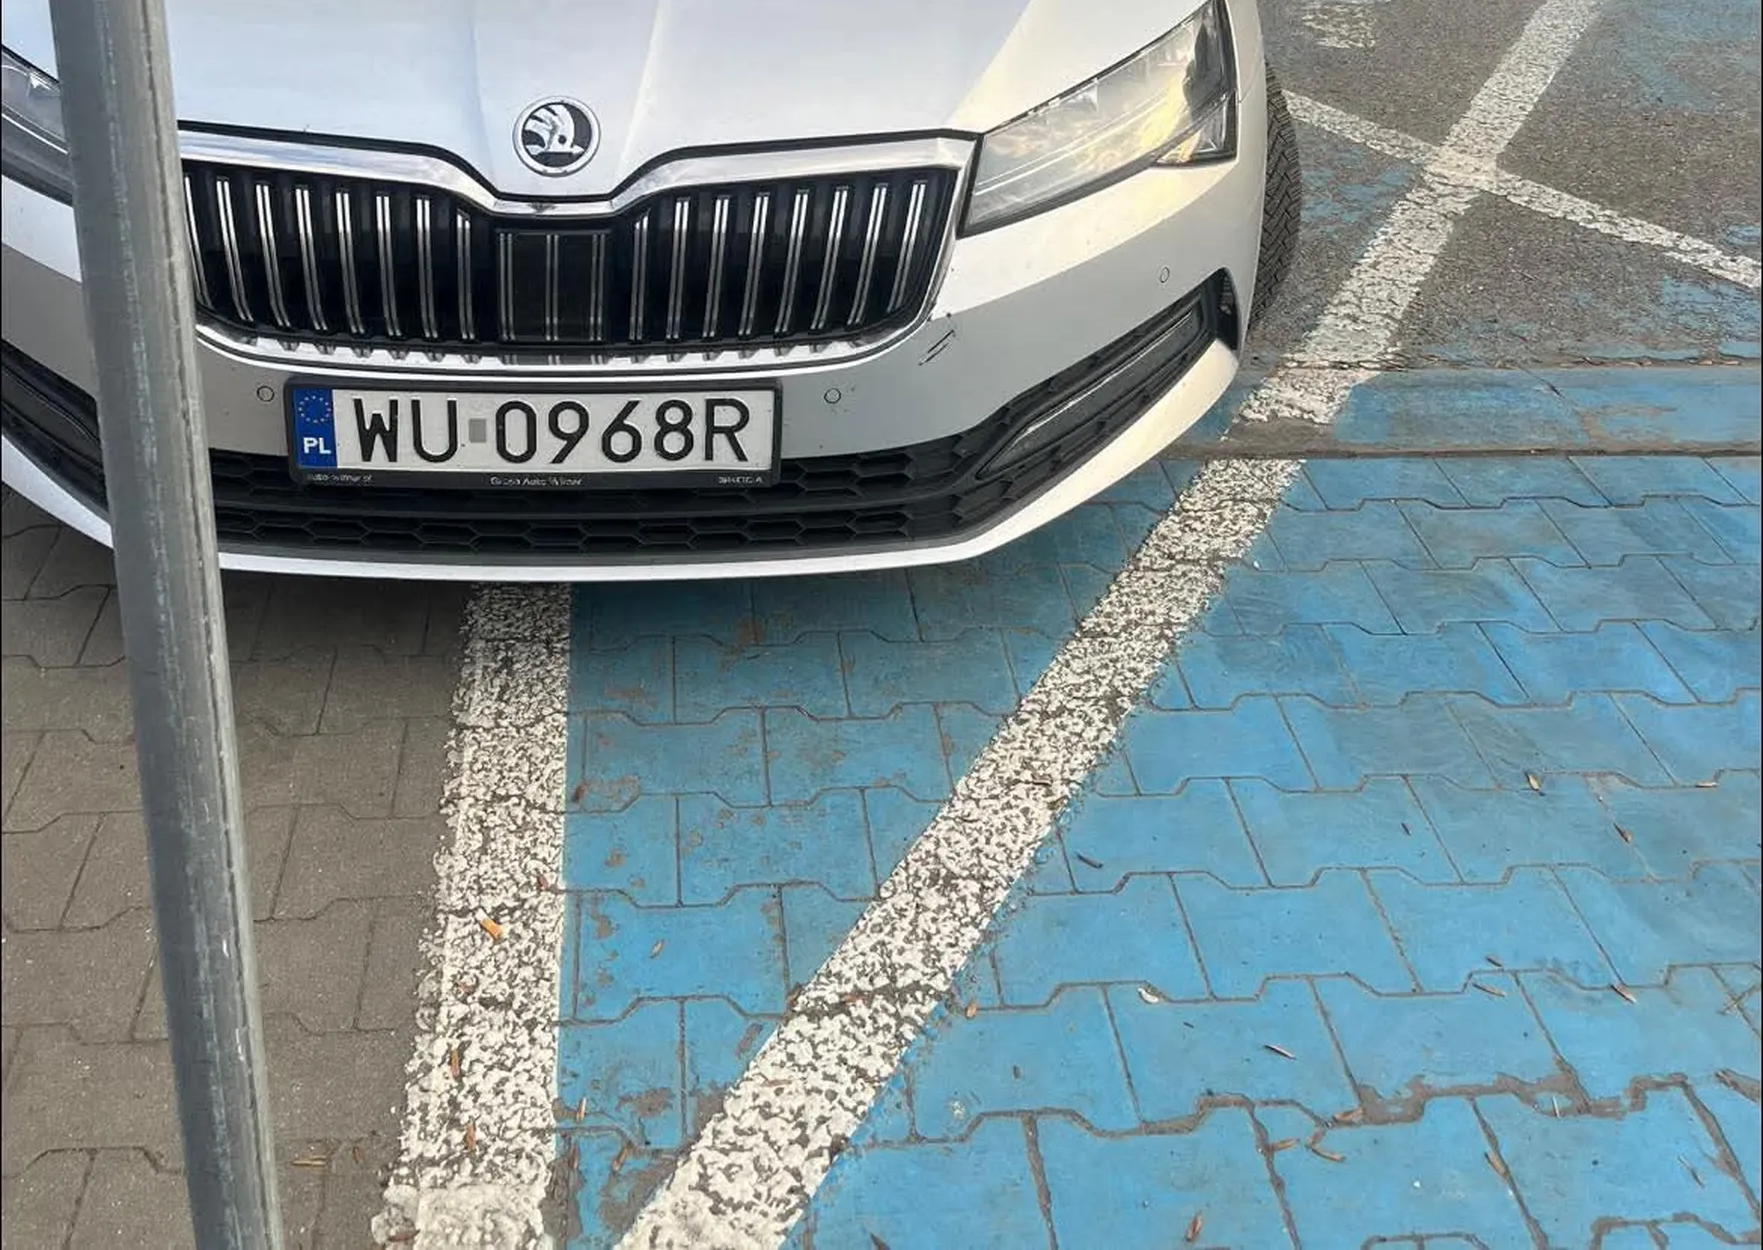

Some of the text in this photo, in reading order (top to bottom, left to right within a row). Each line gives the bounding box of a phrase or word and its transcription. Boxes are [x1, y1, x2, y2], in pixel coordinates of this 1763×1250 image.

[303, 437, 332, 455] PL
[353, 397, 749, 464] WU 0968R
